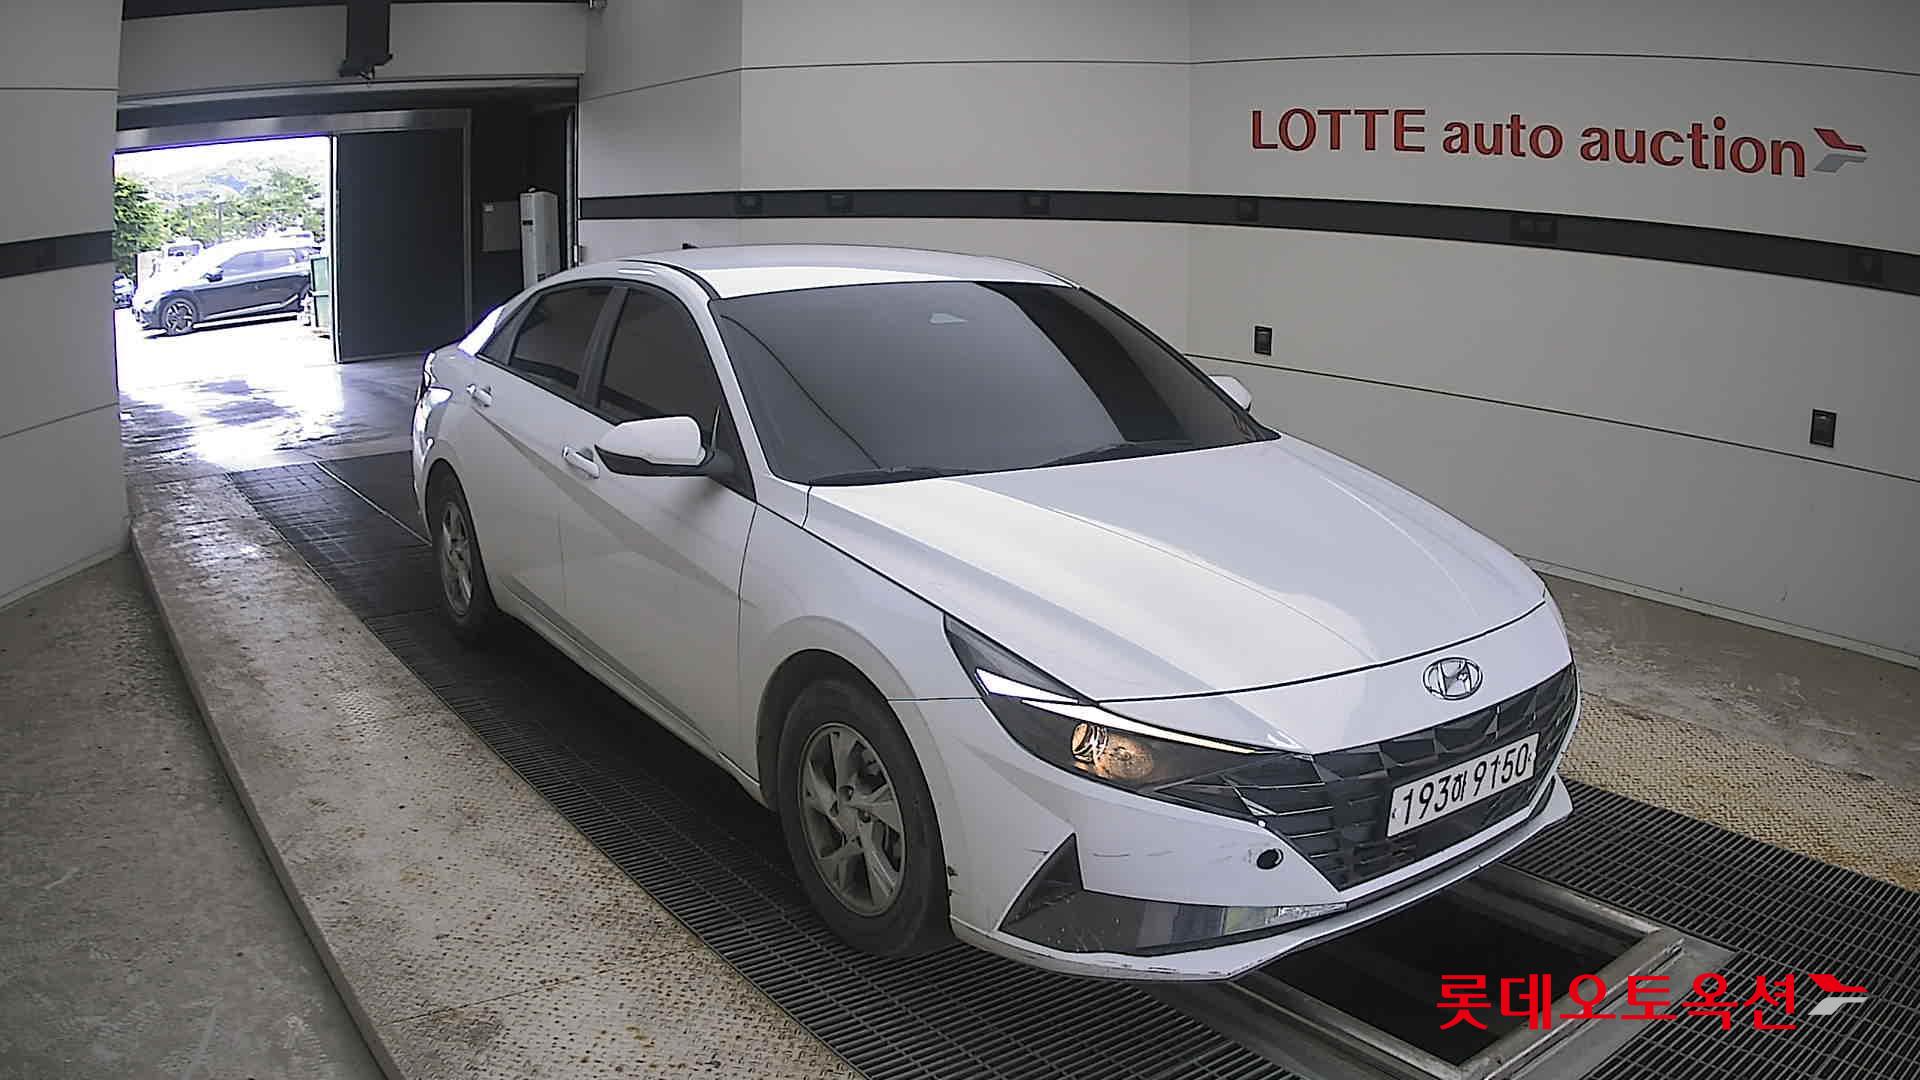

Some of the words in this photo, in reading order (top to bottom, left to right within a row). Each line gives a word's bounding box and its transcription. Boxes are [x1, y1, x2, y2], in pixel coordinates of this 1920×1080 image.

[1251, 108, 1426, 153] LOTTE
[1442, 113, 1564, 159] auto
[1579, 116, 1806, 178] auction
[1473, 743, 1529, 797] 9150
